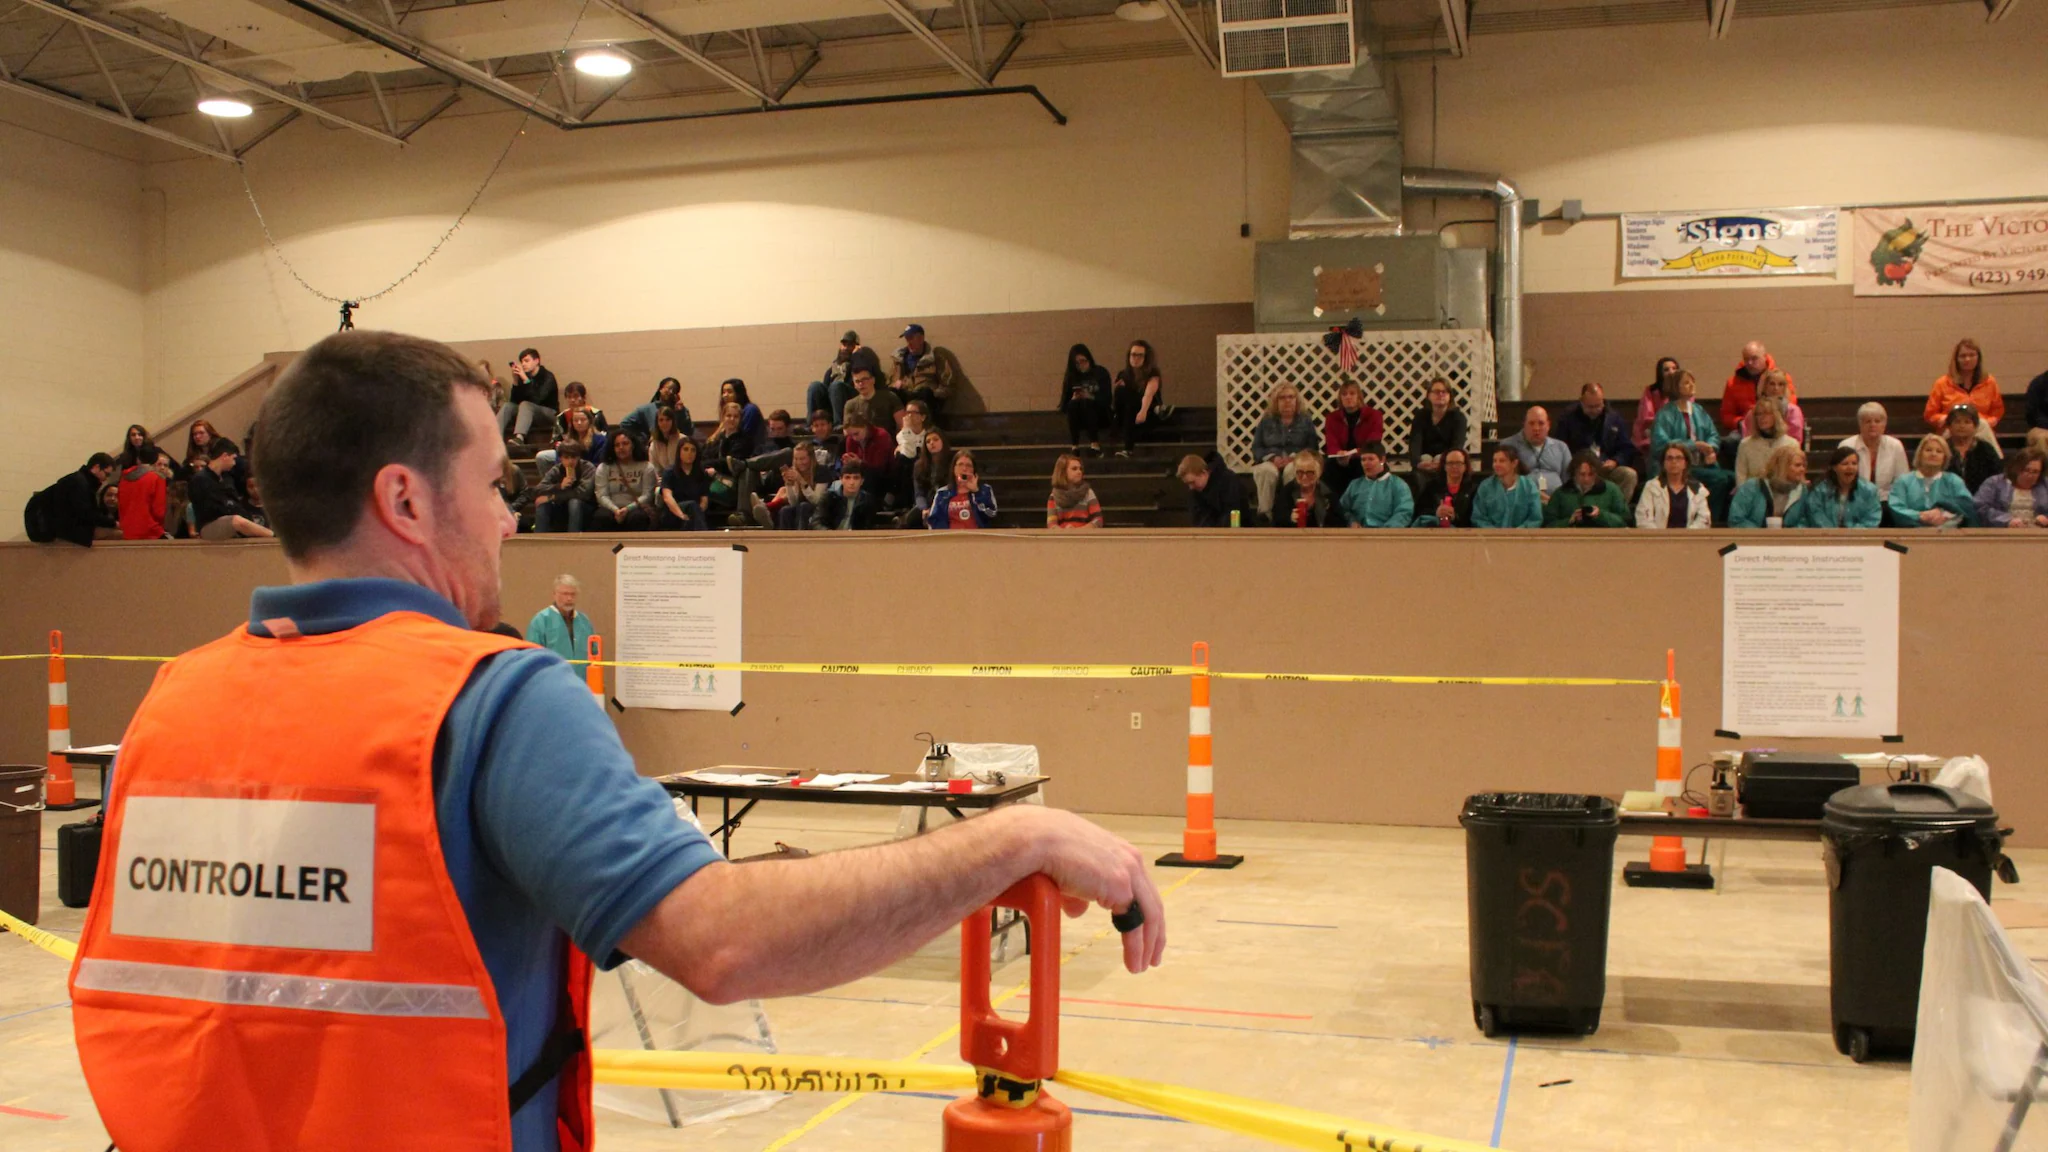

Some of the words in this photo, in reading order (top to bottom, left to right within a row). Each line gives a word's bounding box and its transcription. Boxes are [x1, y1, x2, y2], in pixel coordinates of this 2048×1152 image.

[1686, 219, 1781, 247] Signs
[1926, 218, 1974, 238] THE
[1968, 270, 2011, 287] (423)
[2016, 268, 2048, 281] 949
[643, 554, 675, 563] Monitoring
[1734, 555, 1760, 563] Direct
[1763, 555, 1809, 564] Monitoring
[1812, 555, 1864, 563] Instructions
[821, 665, 860, 673] CAUTION
[972, 666, 1012, 675] CAUTION
[1130, 667, 1173, 676] CAUTION
[128, 856, 352, 904] CONTROLLER
